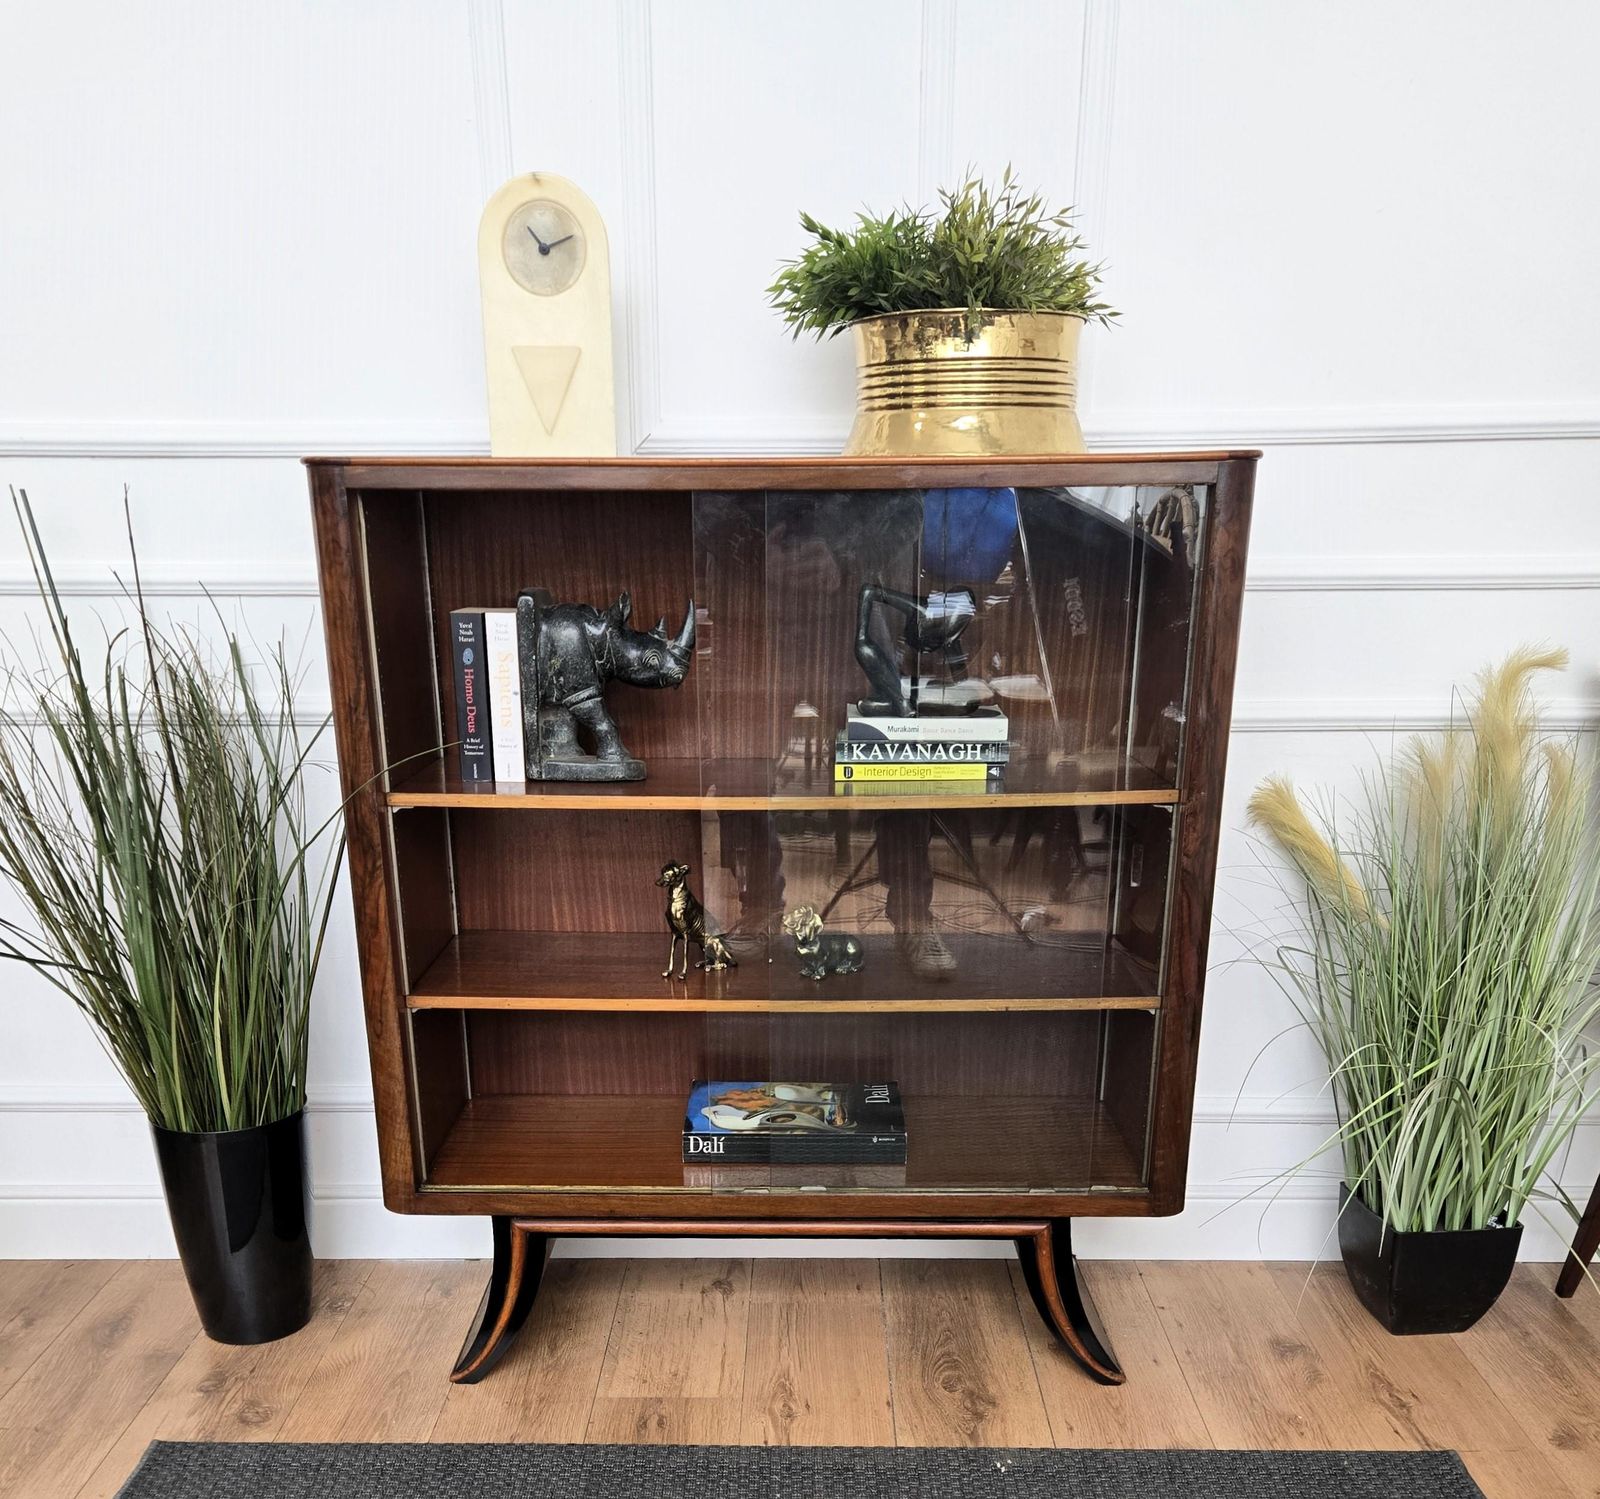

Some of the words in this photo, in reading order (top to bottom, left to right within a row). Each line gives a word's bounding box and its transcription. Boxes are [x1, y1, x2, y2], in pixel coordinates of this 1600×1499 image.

[463, 668, 475, 704] Homo
[494, 651, 515, 729] Sapiens
[465, 705, 478, 734] Deus
[887, 725, 920, 733] Murakami
[851, 743, 982, 760] KAVANAGH
[863, 767, 898, 777] Interior
[899, 766, 932, 778] Design
[865, 1084, 891, 1104] Dalí
[687, 1136, 725, 1154] Dalí
